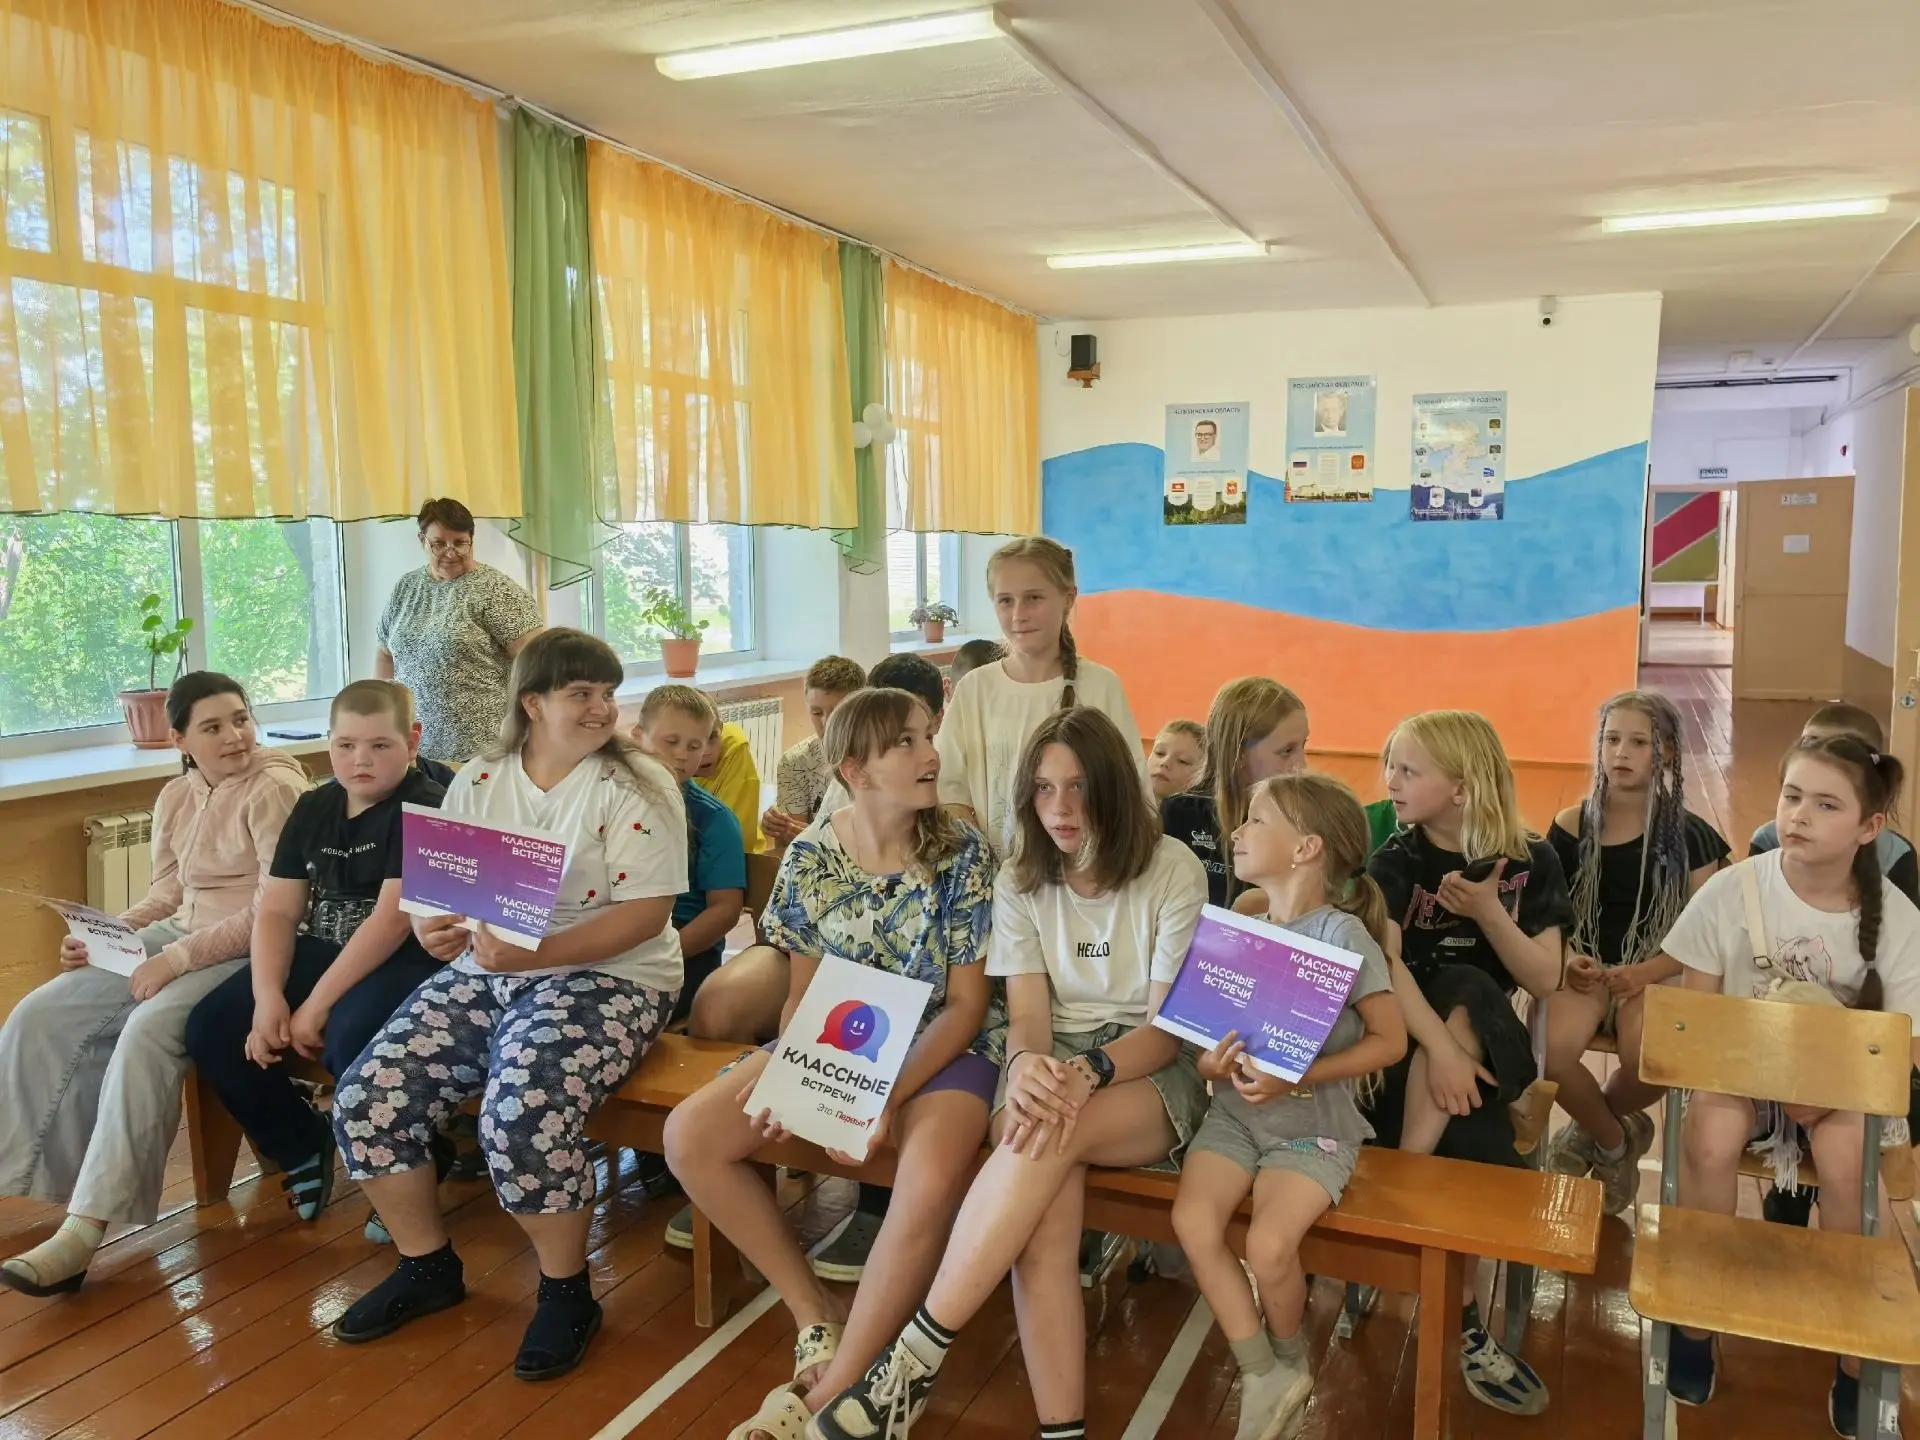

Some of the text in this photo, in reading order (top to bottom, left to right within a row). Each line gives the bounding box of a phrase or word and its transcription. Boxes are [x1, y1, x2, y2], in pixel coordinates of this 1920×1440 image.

[418, 847, 479, 868] КЛАССНЫЕ
[501, 835, 563, 856] КЛАССНЫЕ
[512, 847, 562, 866] ВСТРЕЧИ
[428, 859, 478, 877] ВСТРЕЧИ
[494, 894, 551, 918] КЛАССНЫЕ
[502, 907, 547, 928] ВСТРЕЧИ
[1077, 941, 1110, 958] HELLO
[1197, 960, 1257, 989] КЛАССНЫЕ
[1289, 952, 1355, 982] КЛАССНЫЕ
[1203, 974, 1252, 1001] ВСТРЕЧИ
[1296, 968, 1349, 994] ВСТРЕЧИ
[1261, 1021, 1321, 1053] КЛАССНЫЕ
[1267, 1038, 1314, 1063] ВСТРЕЧИ
[782, 1046, 890, 1097] КЛАССНЫЕ
[801, 1076, 856, 1105] ВСТРЕЧИ
[816, 1103, 833, 1115] Это
